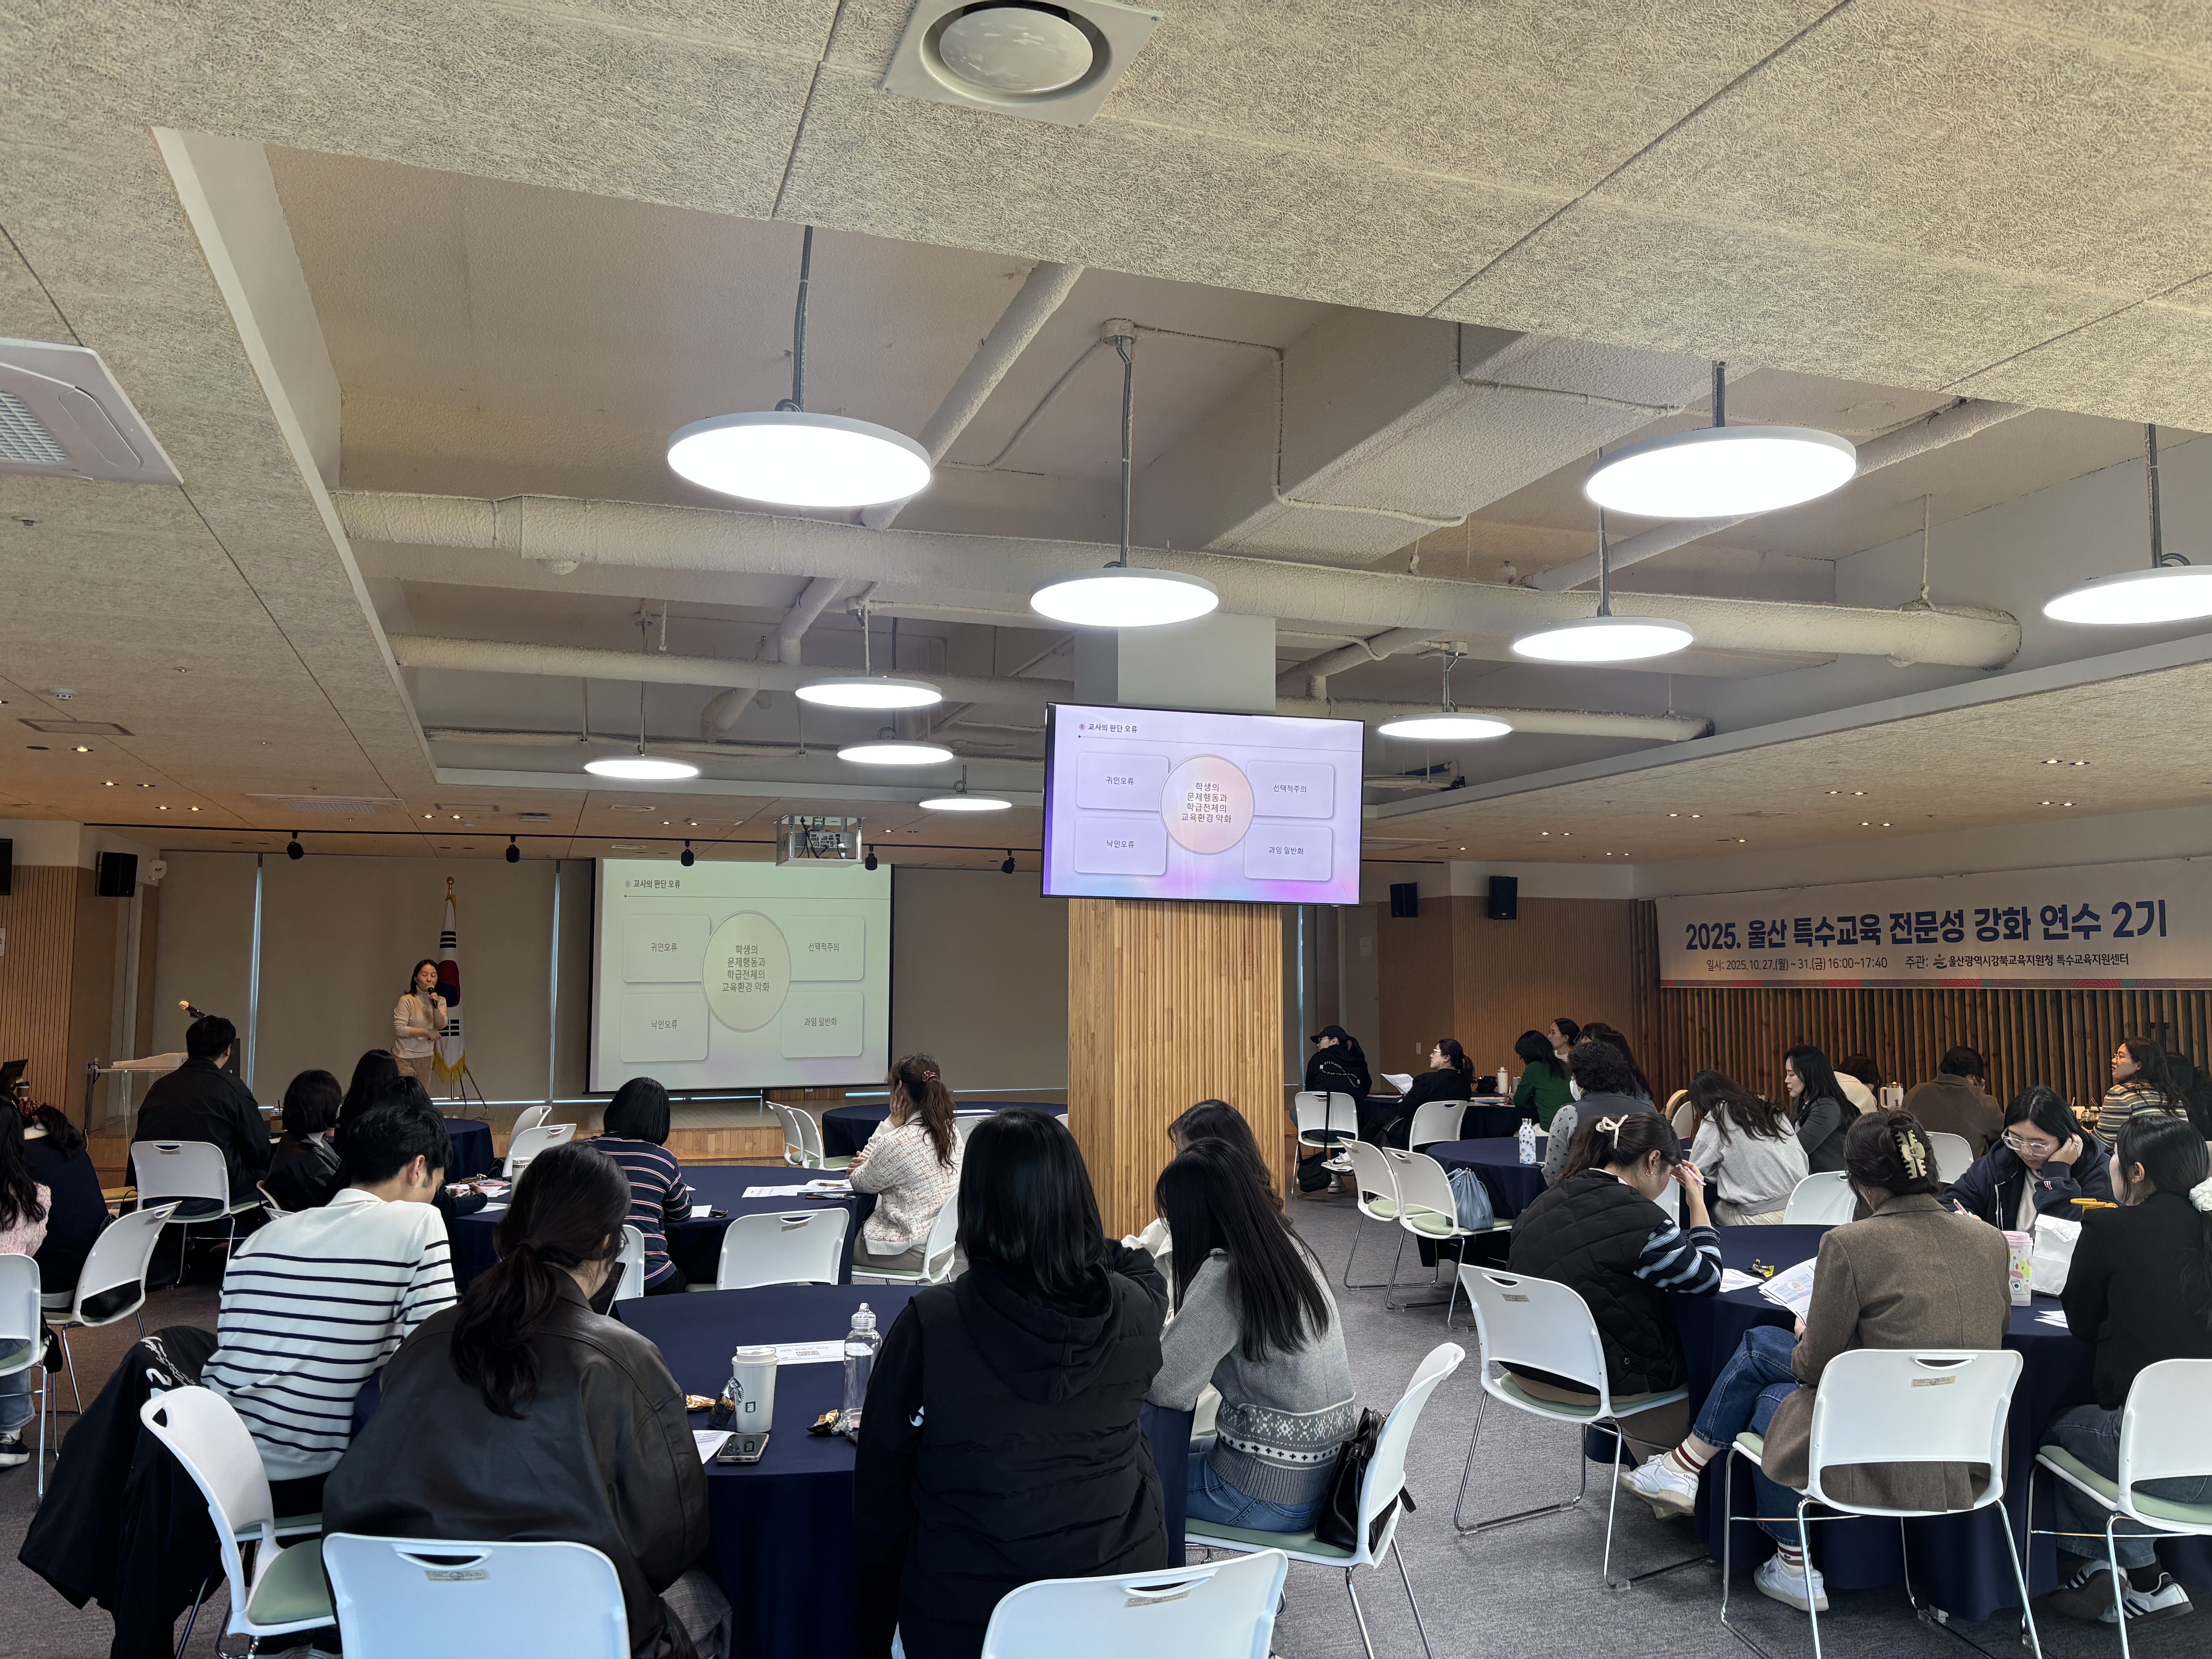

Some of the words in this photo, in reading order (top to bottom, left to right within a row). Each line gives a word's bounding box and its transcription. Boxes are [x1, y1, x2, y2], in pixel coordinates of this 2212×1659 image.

[1088, 723, 1108, 732] 교사의
[1109, 725, 1123, 733] 판단
[1106, 776, 1134, 785] 귀인오류
[1195, 782, 1219, 792] 학생의
[1273, 784, 1307, 793] 선택적주의
[1187, 792, 1228, 802] 문제행동과
[1187, 802, 1226, 813] 학급전체의
[1181, 813, 1213, 823] 교육환경
[1216, 814, 1232, 823] 악화
[1107, 840, 1135, 849] 낙인오류
[1268, 846, 1282, 854] 과잉
[1284, 847, 1304, 855] 일반화
[633, 879, 653, 889] 교사의
[654, 879, 667, 889] 판단
[668, 880, 681, 889] 오류
[1685, 922, 1741, 950] 2025.
[1748, 919, 1787, 949] 울산
[1793, 914, 1882, 947] 특수교육
[1889, 909, 1965, 945] 전문성
[1974, 906, 2031, 942] 강화
[2040, 903, 2102, 940] 연수
[2111, 899, 2167, 938] 2기
[650, 943, 678, 952] 귀인오류
[735, 945, 758, 955] 학생의
[808, 942, 840, 952] 선택적주의
[727, 957, 766, 968] 문제행동과
[1707, 959, 1724, 972] 일시:
[1726, 958, 1788, 971] 2025.10.27.(월)
[1798, 957, 1826, 970] 31.(금)
[1828, 957, 1887, 969] 16:00~17:40
[1905, 955, 1929, 969] 주관:
[1948, 954, 2053, 967] 울산광역시강북교육지원청
[2056, 953, 2129, 966] 특수교육지원센터
[727, 969, 765, 980] 학급전체의
[722, 982, 752, 993] 교육환경
[755, 982, 770, 993] 악화
[651, 1020, 678, 1029] 낙인오류
[804, 1017, 817, 1027] 과잉
[818, 1017, 837, 1027] 일반화
